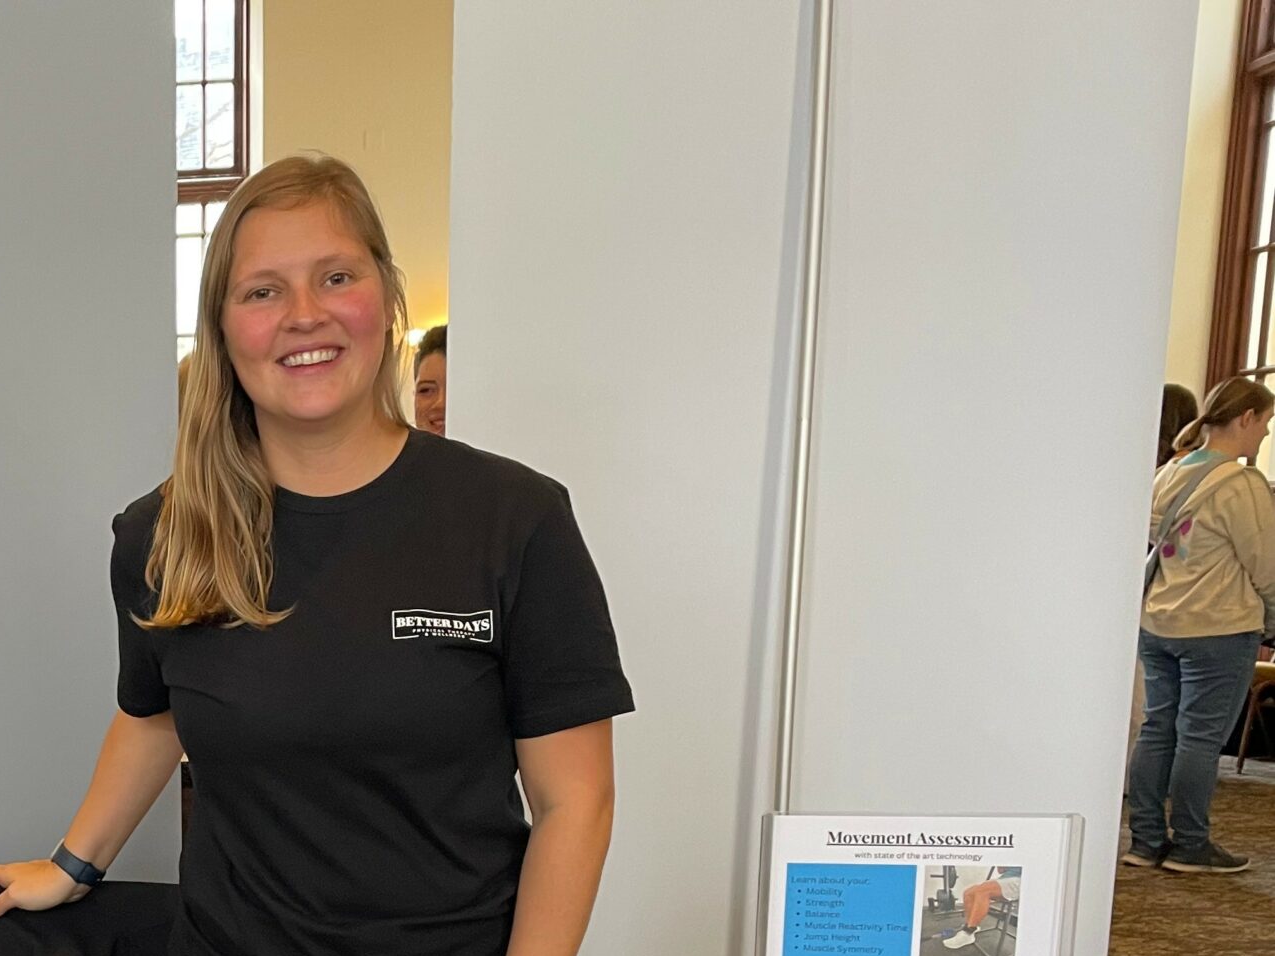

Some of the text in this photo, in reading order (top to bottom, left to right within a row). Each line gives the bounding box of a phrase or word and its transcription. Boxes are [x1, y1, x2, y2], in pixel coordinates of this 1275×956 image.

[396, 616, 490, 632] BETTER DAYS
[827, 831, 1014, 846] Movement Assessment
[936, 853, 983, 861] technology
[790, 875, 816, 883] Learn
[818, 876, 844, 884] about
[805, 887, 843, 897] Mobility
[805, 899, 844, 908] Strength
[804, 910, 840, 918] Balance
[804, 921, 910, 932] Muscle Reactivity Time
[803, 933, 860, 943] Jump Height
[802, 944, 885, 955] Muscle Symmetry
